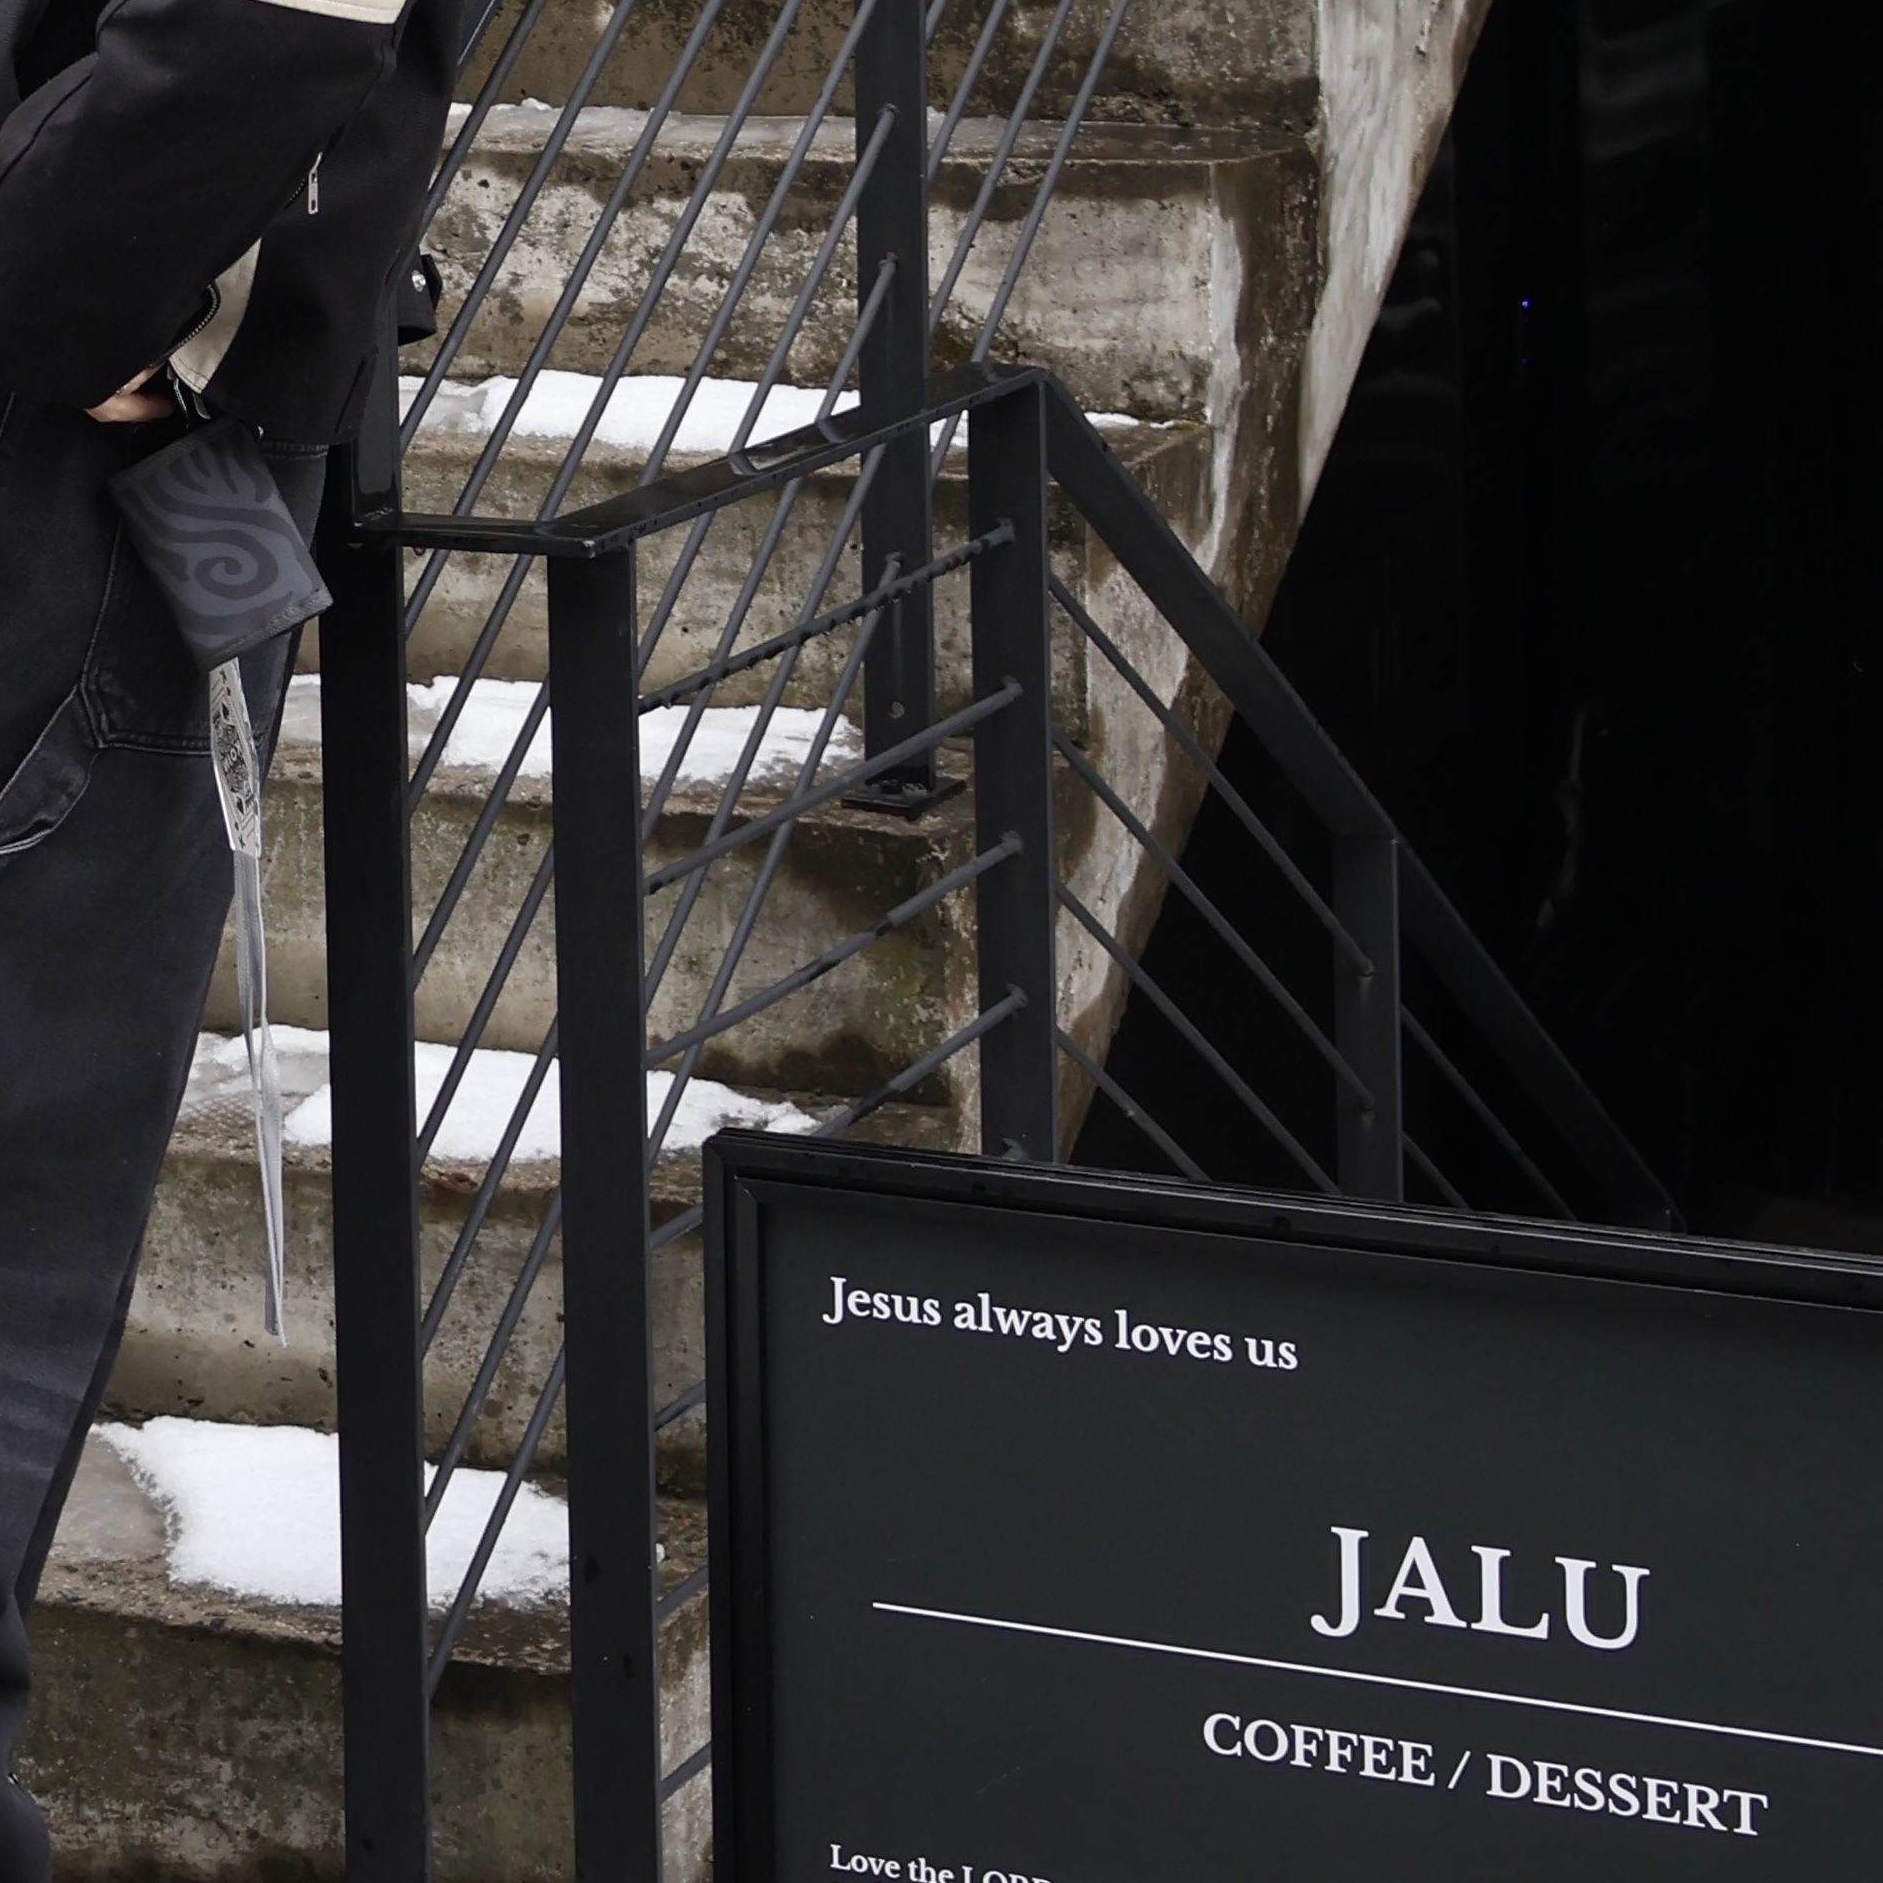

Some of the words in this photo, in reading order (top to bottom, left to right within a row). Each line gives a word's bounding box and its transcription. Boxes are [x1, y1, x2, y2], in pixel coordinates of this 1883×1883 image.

[822, 1276, 942, 1326] Jesus
[953, 1292, 1104, 1353] always
[1114, 1309, 1233, 1362] loves
[1244, 1337, 1299, 1370] us
[1310, 1526, 1651, 1650] JALU
[1203, 1712, 1436, 1787] COFFEE
[1485, 1753, 1769, 1836] DESSERT
[830, 1843, 901, 1879] Love
[907, 1857, 955, 1883] the
